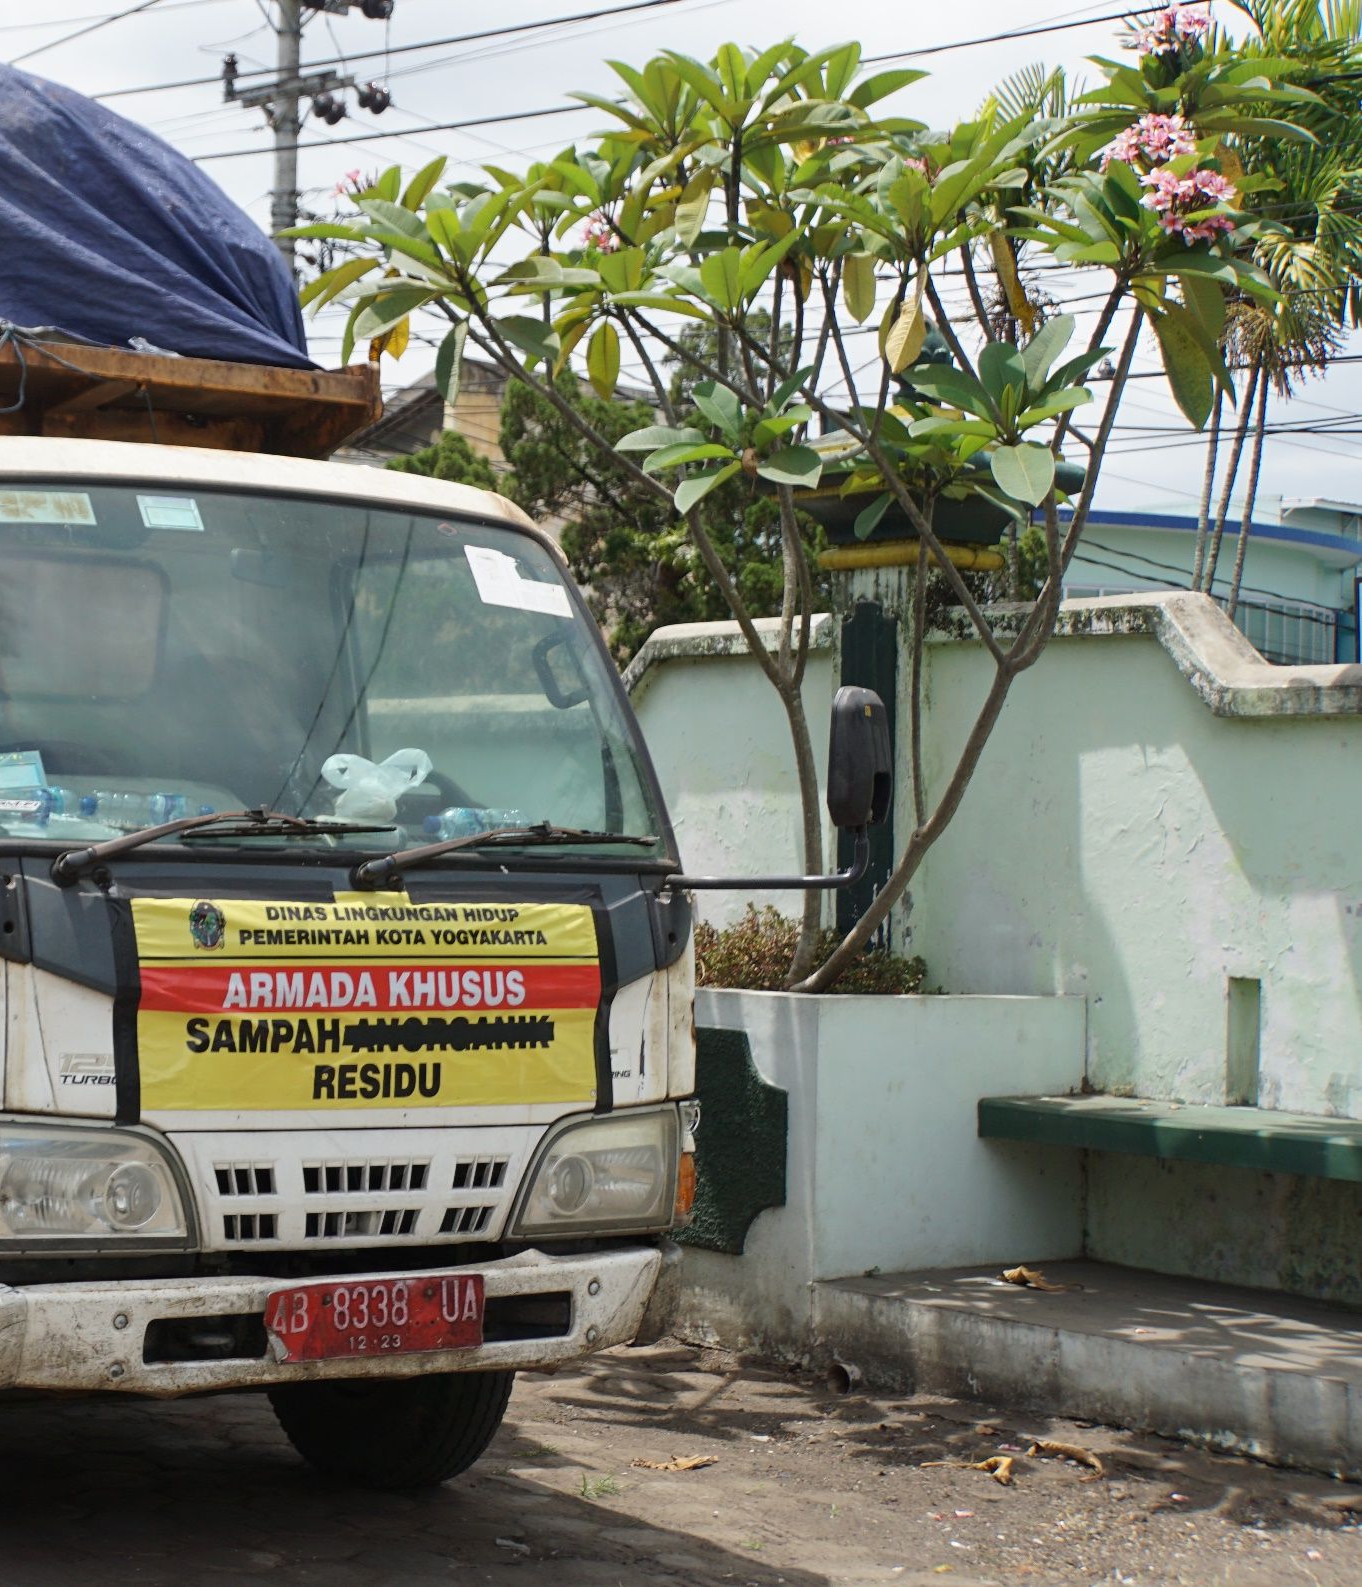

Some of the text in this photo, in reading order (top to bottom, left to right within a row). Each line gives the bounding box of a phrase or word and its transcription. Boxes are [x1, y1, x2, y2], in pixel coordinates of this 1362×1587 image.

[265, 906, 519, 922] DINAS LINGKUNGAN HIDUP
[239, 929, 548, 946] PEMERINTAH KOTA YOGYAKARTA
[222, 969, 526, 1009] ARMADA KHUSUS
[185, 1017, 340, 1055] SAMPAH
[312, 1062, 441, 1100] RESIDU
[271, 1279, 478, 1334] AB 8338 UA
